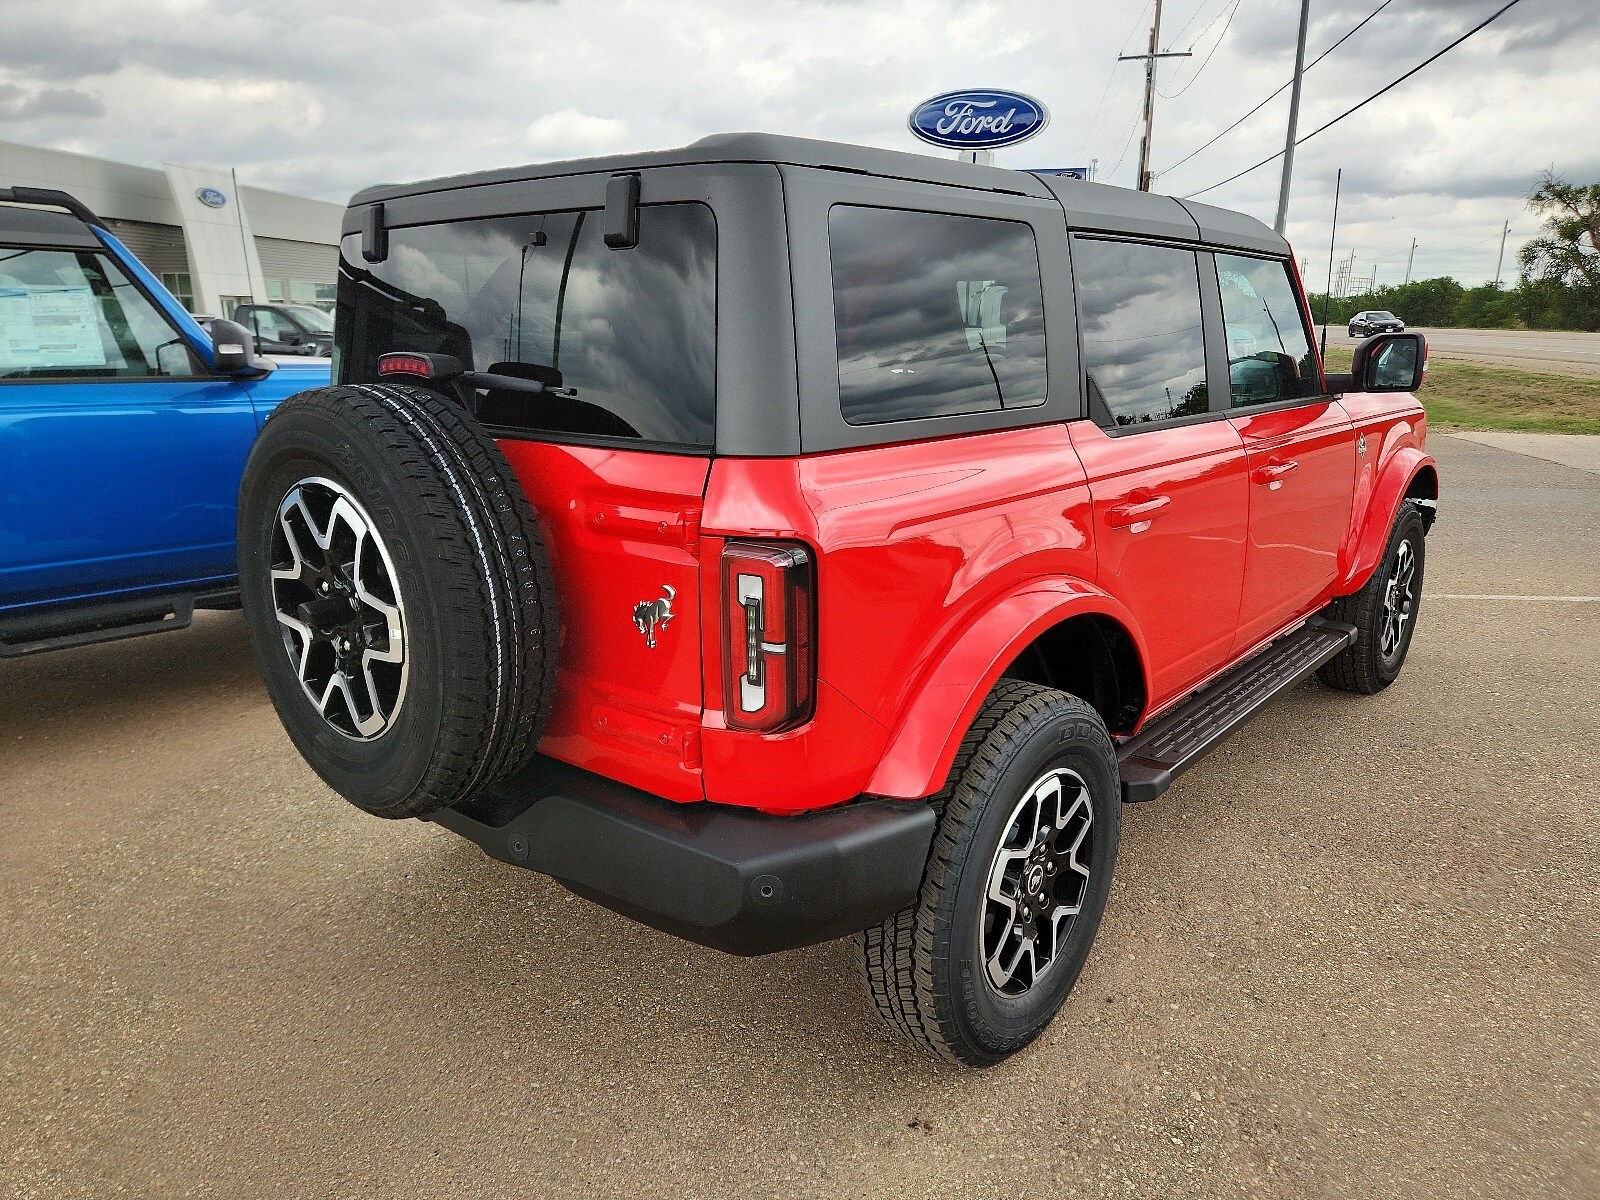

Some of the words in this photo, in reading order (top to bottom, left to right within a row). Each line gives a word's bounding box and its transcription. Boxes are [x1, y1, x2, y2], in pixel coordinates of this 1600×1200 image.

[936, 101, 1016, 134] Ford
[205, 191, 222, 203] Ford
[960, 958, 1063, 1051] IDGESTONE
